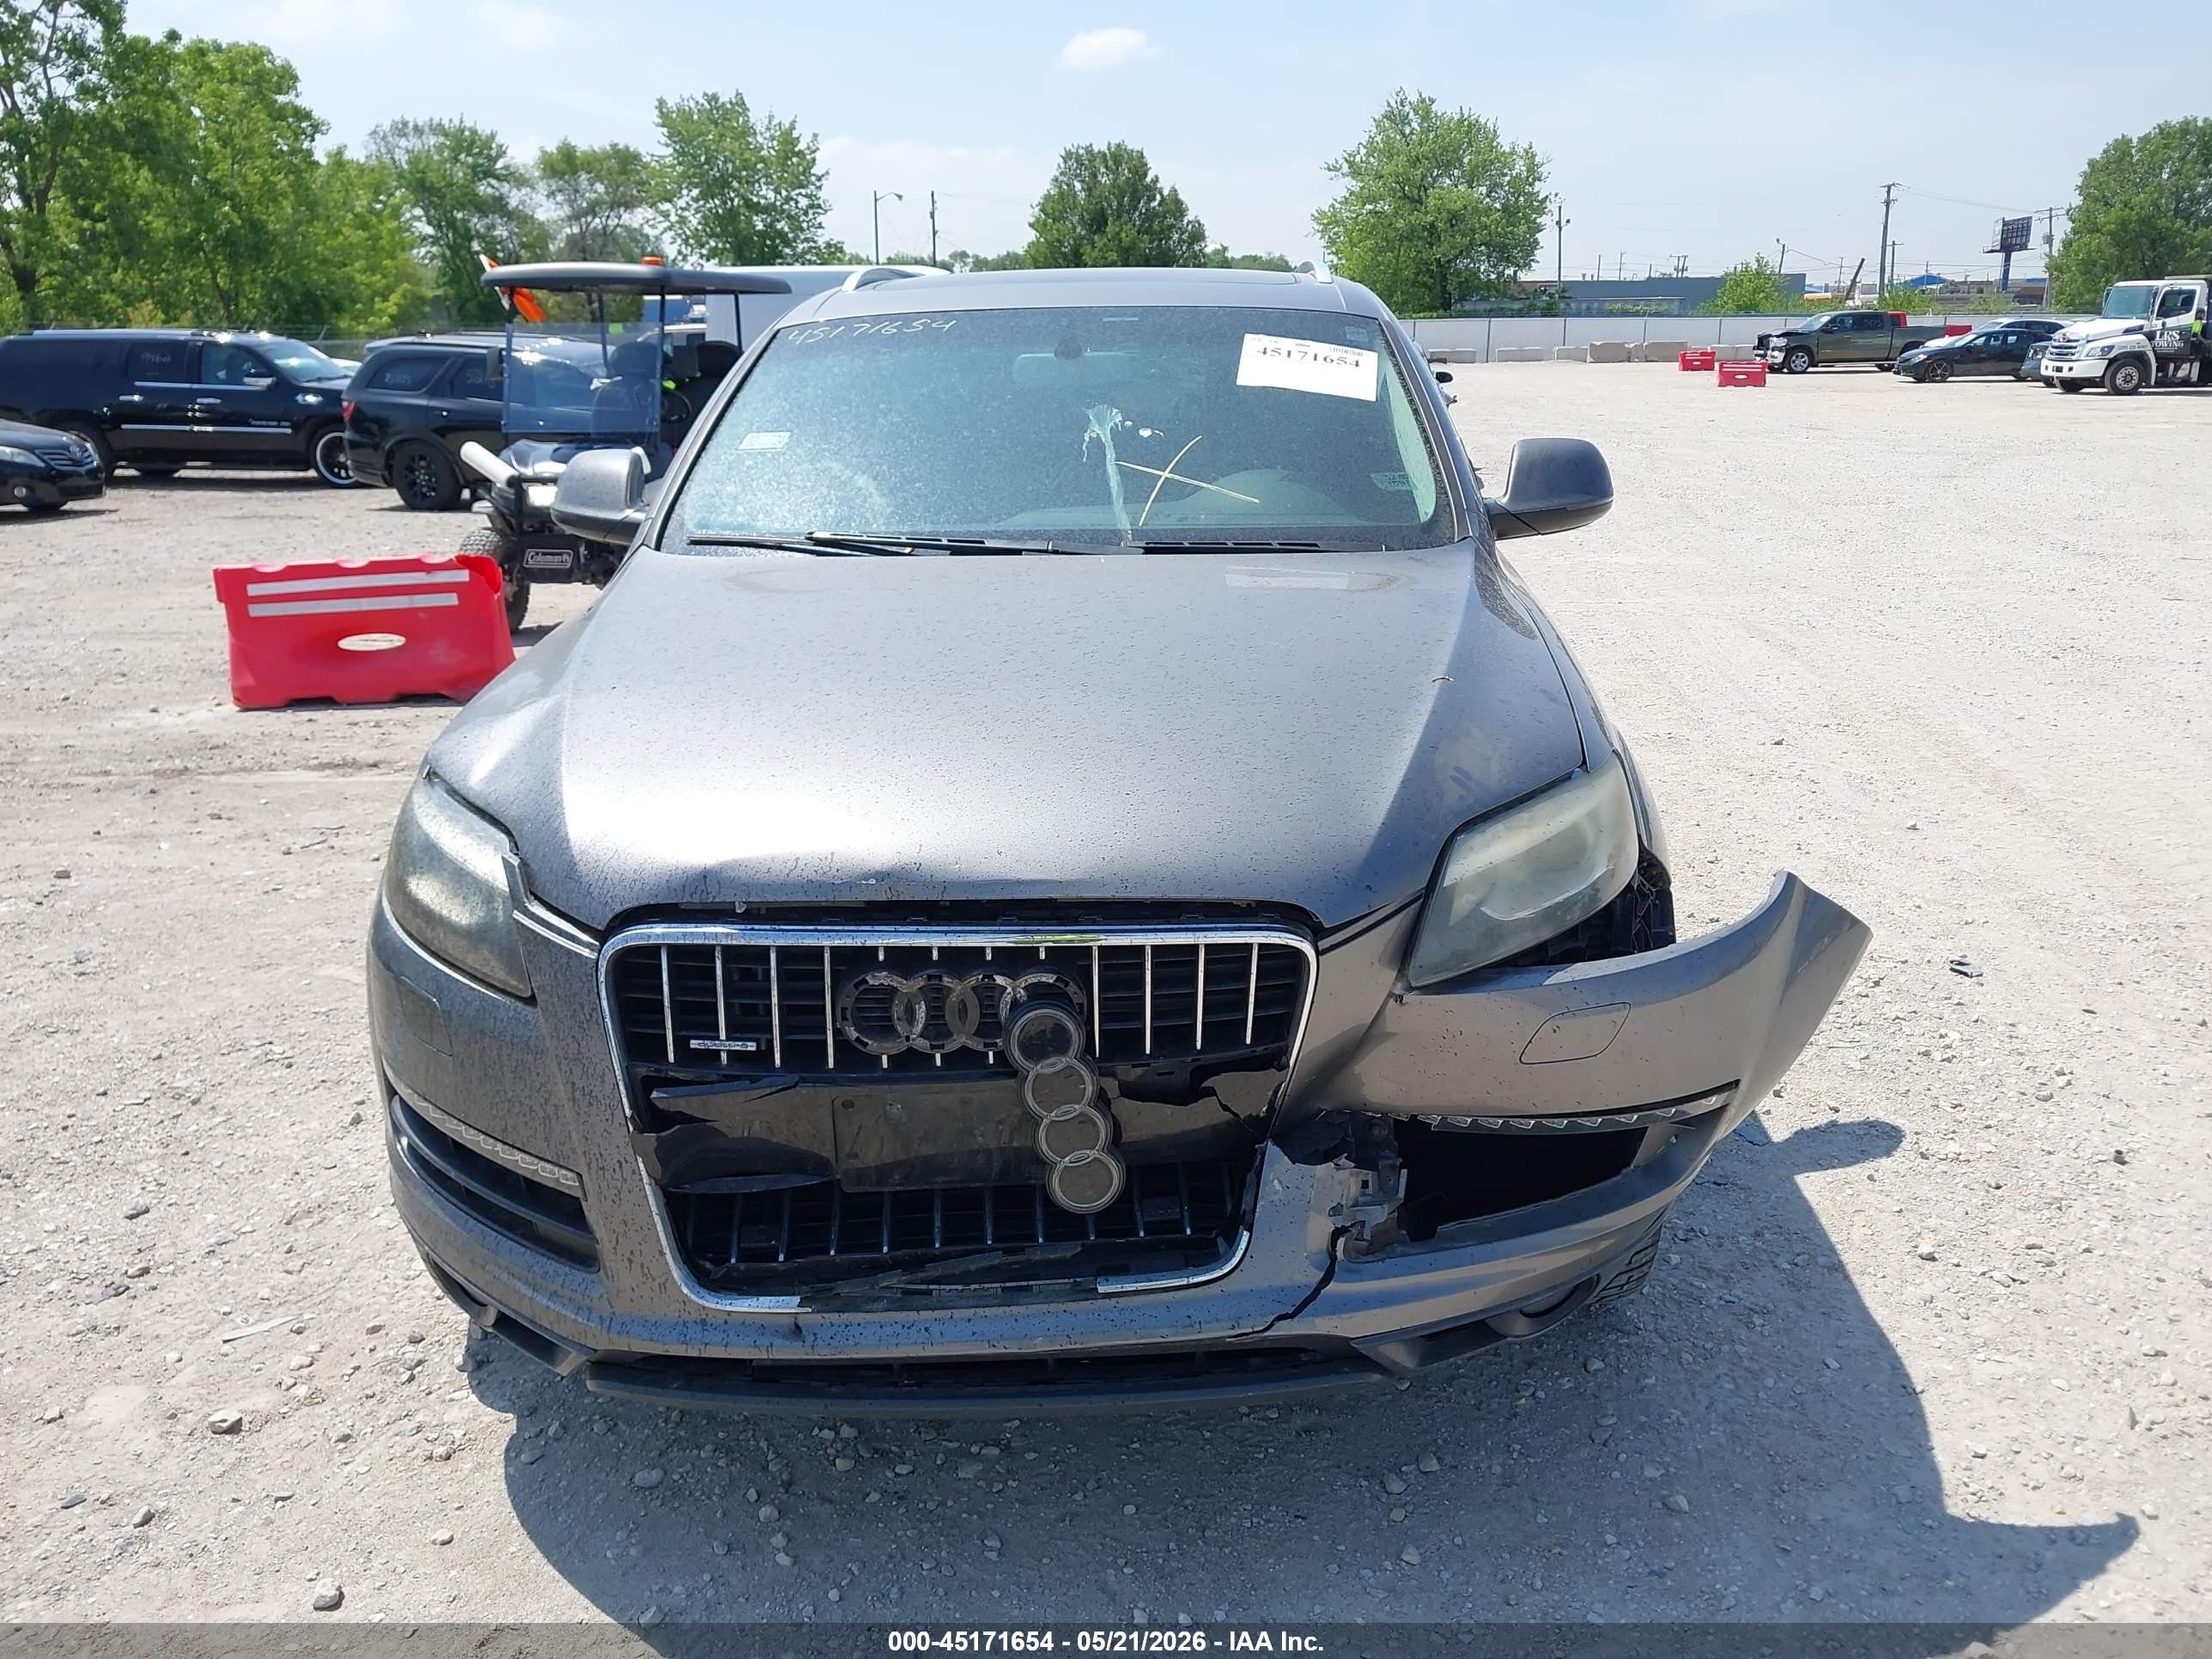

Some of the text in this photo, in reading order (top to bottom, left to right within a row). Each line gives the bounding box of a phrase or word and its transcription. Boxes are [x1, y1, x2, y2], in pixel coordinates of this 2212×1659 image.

[788, 319, 957, 344] 45171654
[2154, 330, 2180, 341] LRS
[1257, 346, 1361, 368] 45171654
[527, 551, 562, 563] Coleman
